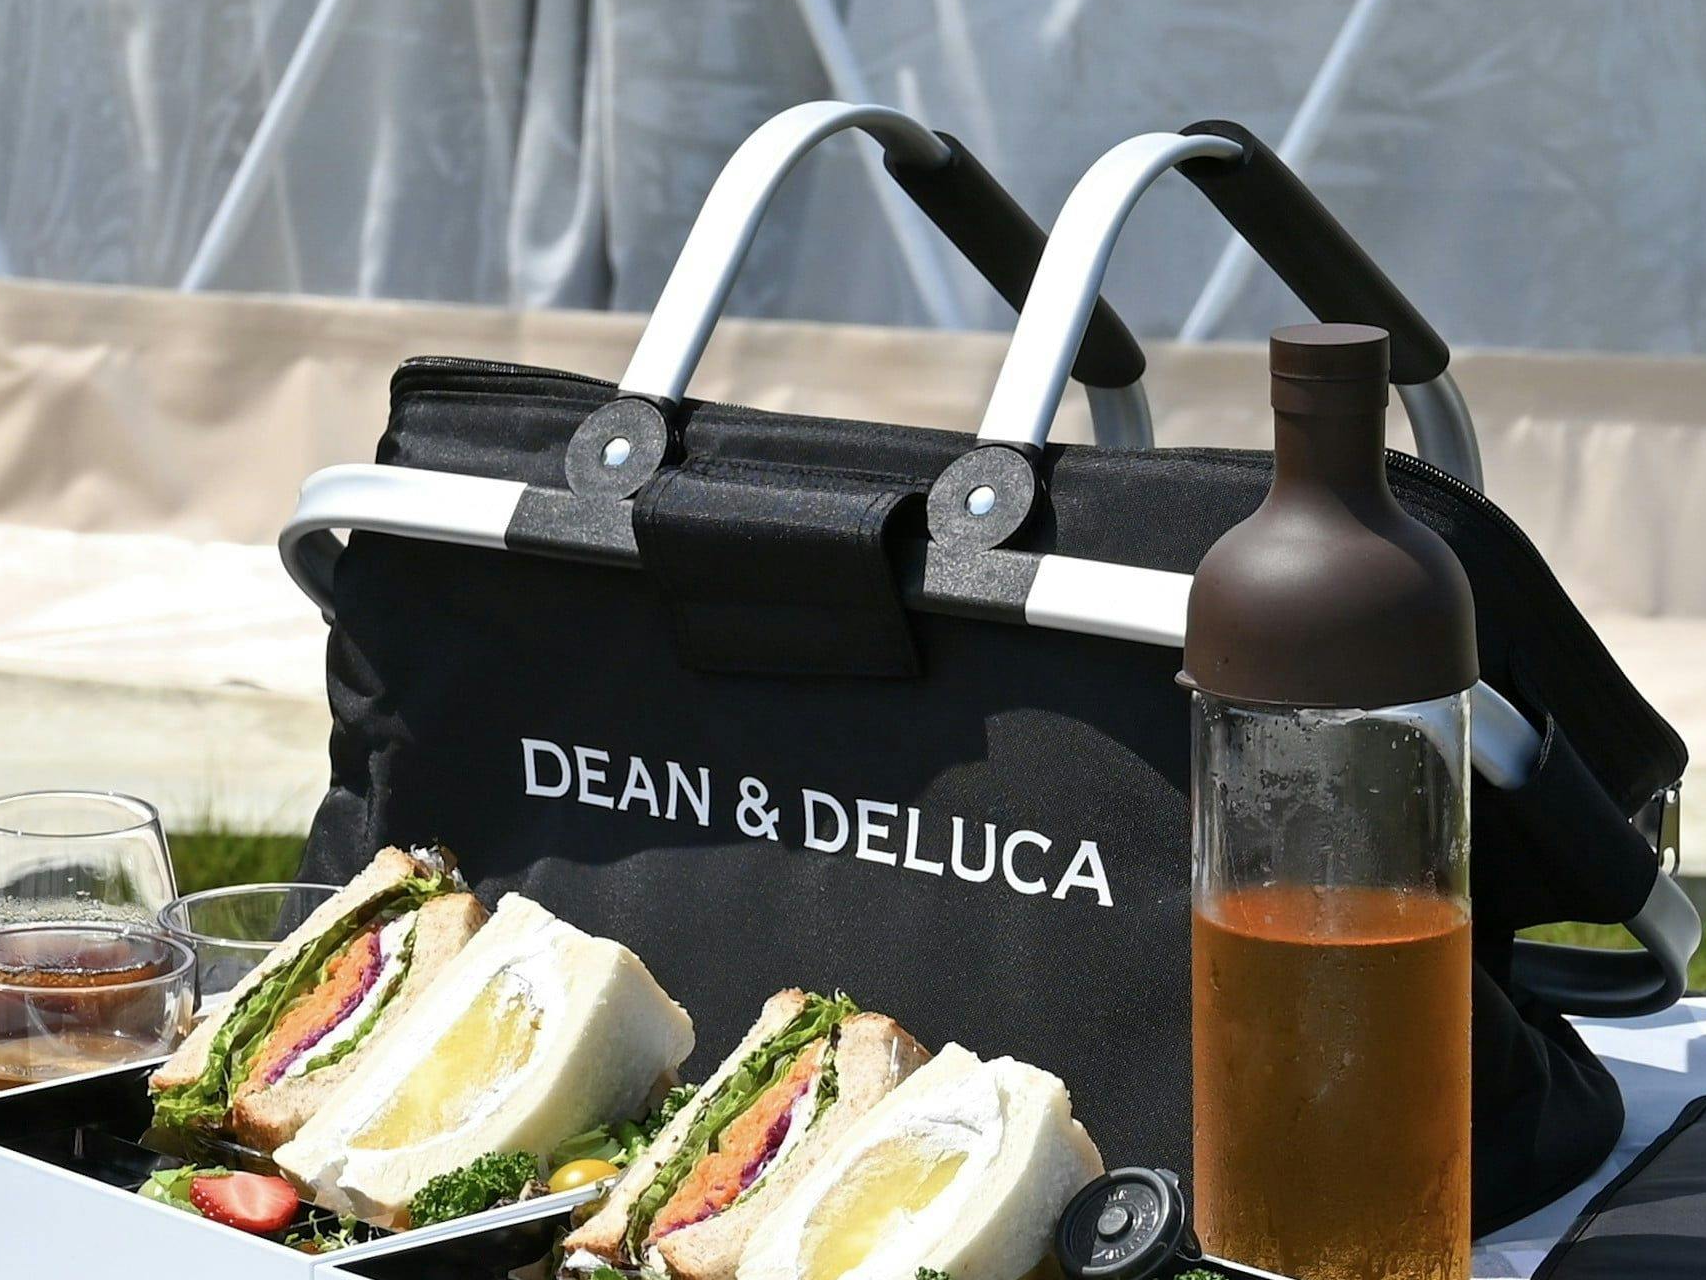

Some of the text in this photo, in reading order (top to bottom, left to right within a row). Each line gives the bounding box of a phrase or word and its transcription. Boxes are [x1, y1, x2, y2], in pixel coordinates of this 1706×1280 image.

[521, 737, 1114, 908] DEAN & DELUCA
